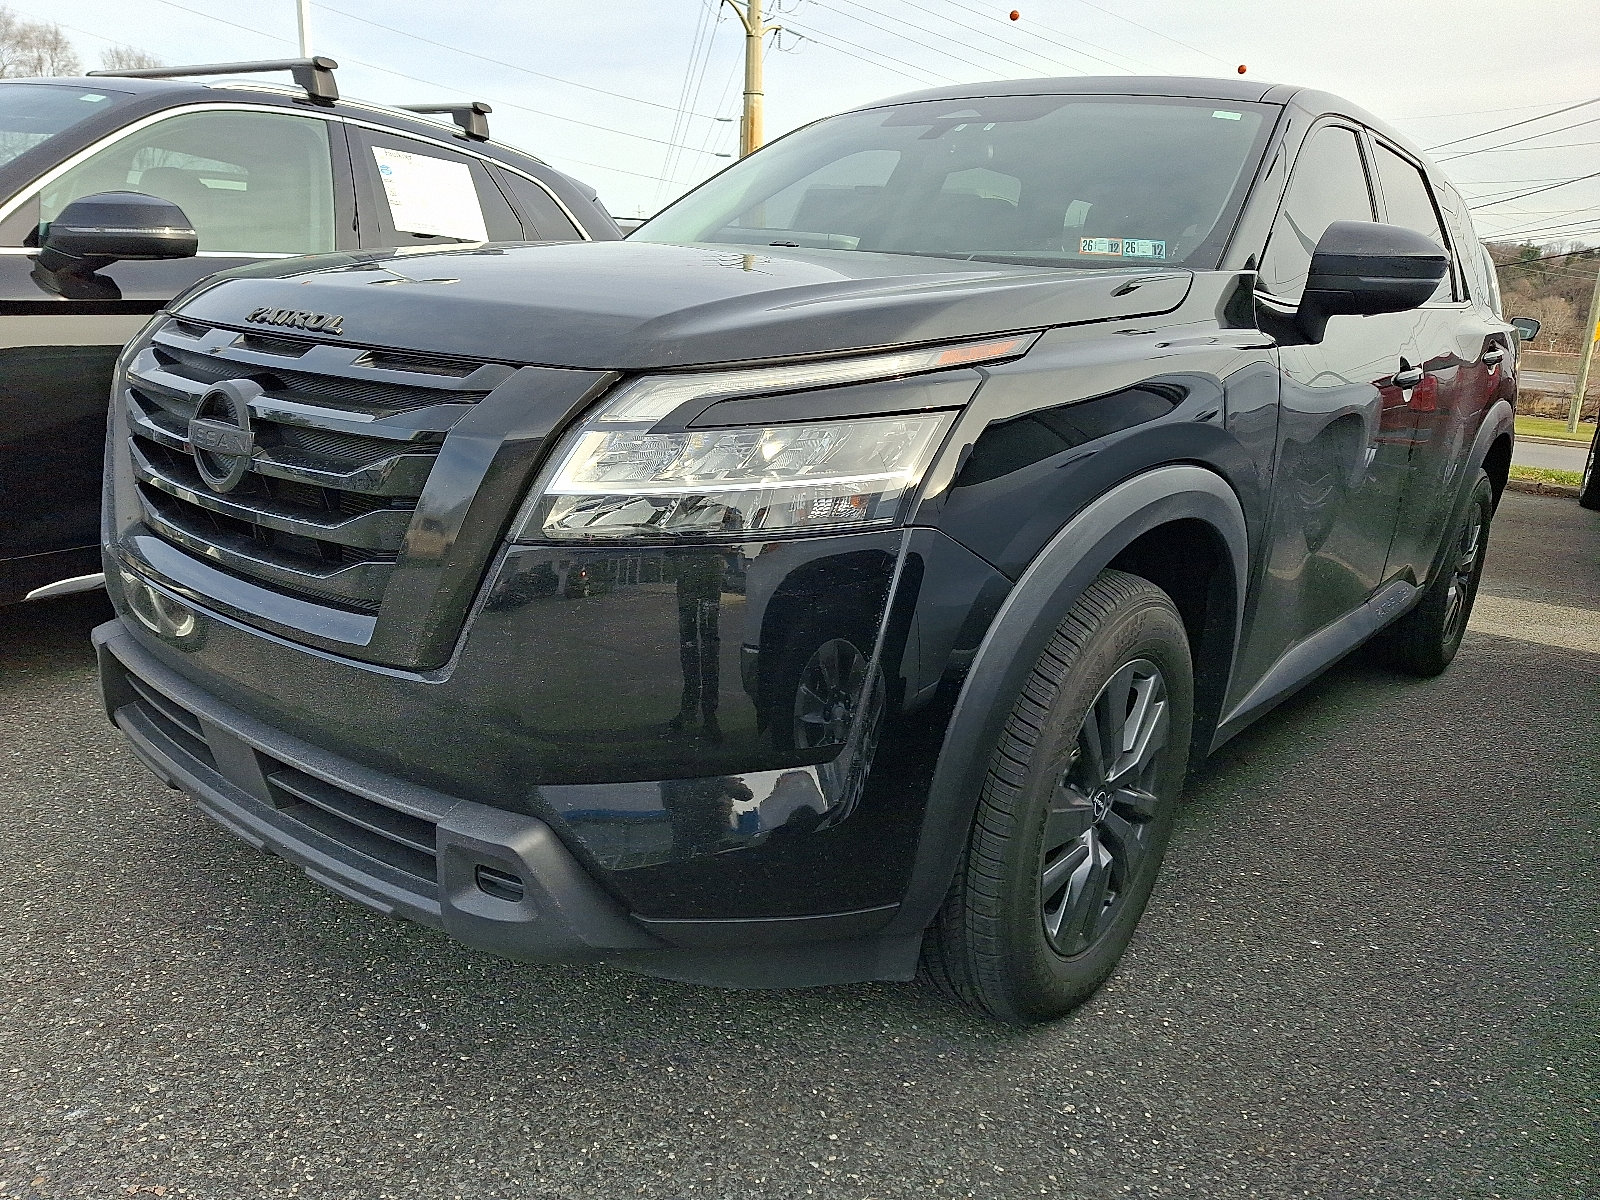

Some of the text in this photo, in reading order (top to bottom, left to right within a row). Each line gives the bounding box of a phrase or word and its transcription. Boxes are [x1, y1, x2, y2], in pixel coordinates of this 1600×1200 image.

[1082, 239, 1119, 253] 26 12
[1125, 241, 1164, 256] 26 12
[245, 307, 343, 336] PATROL
[190, 424, 249, 453] SSAN
